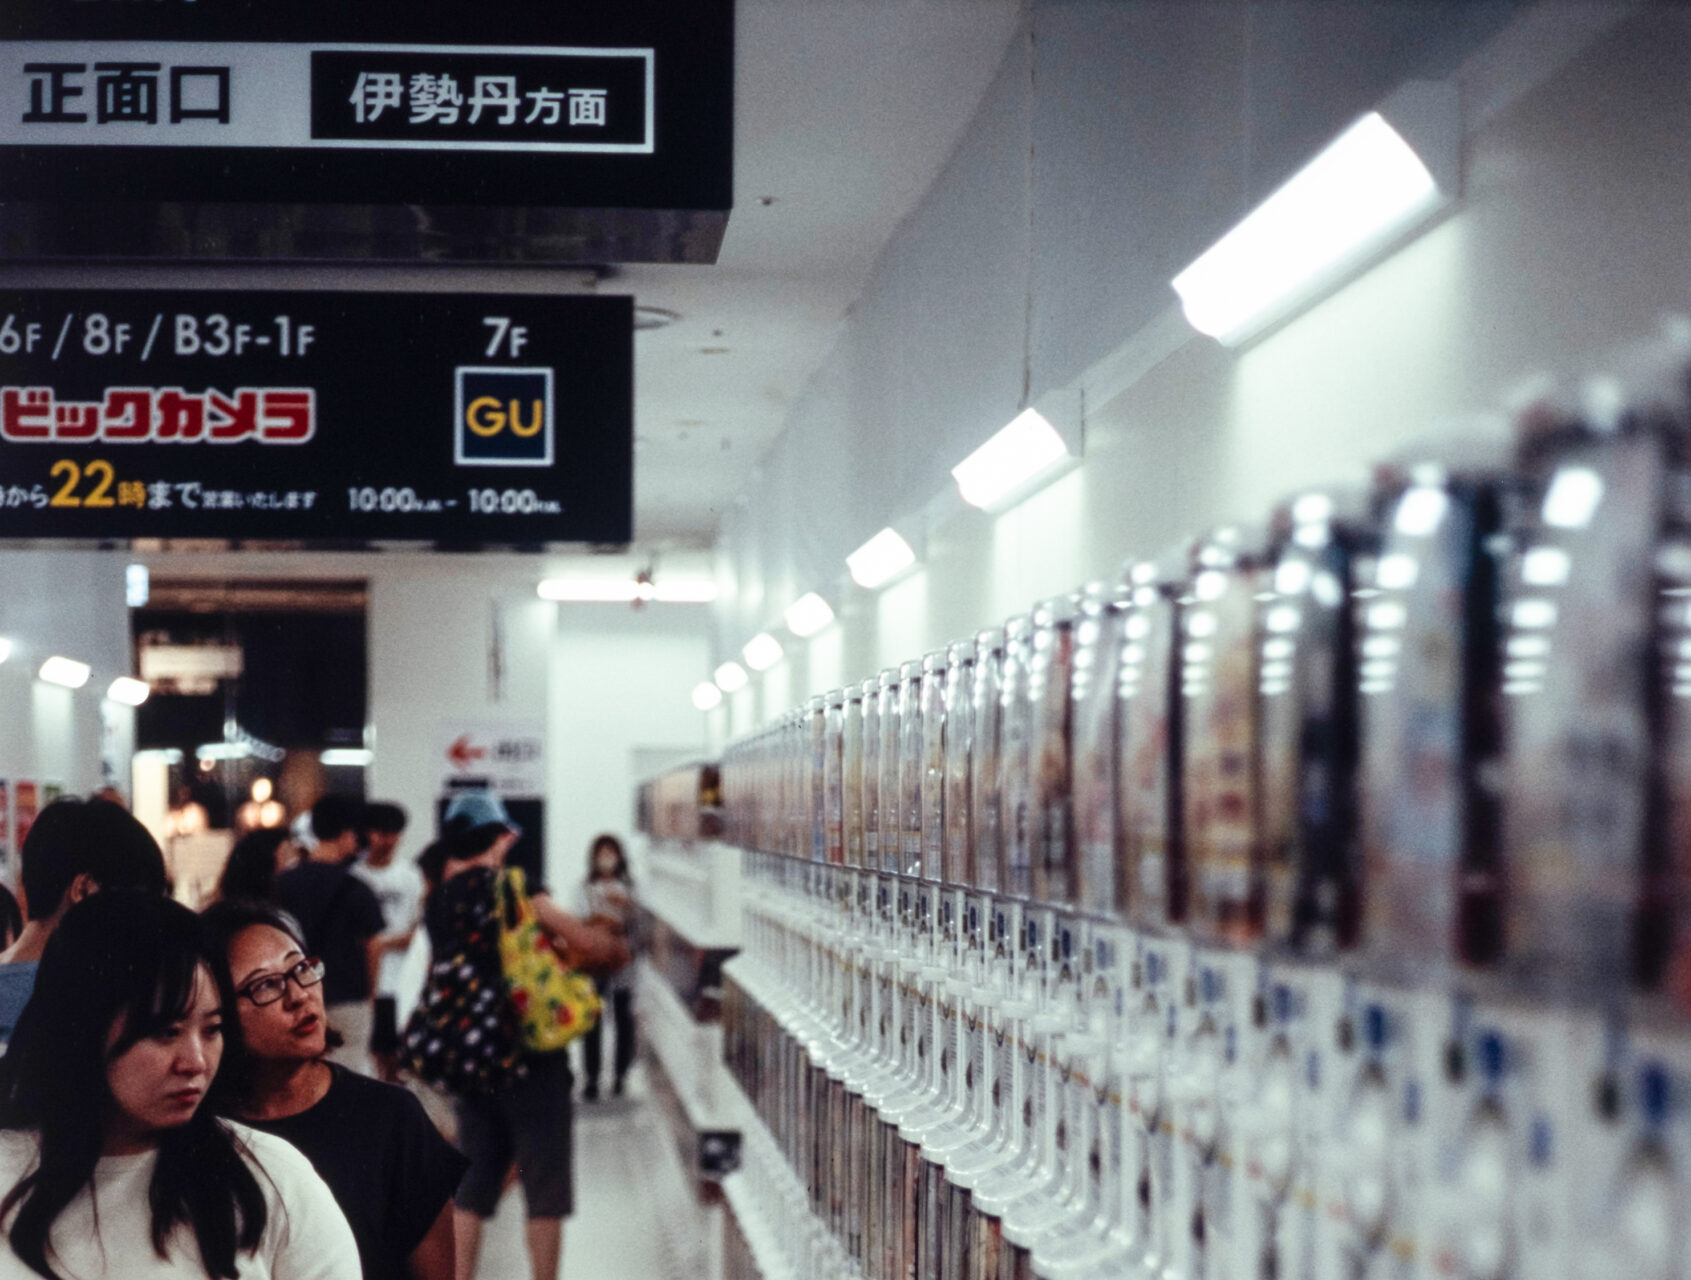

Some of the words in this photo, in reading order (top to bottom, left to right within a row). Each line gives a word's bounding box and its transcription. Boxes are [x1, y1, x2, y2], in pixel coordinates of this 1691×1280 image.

[22, 62, 231, 125] 正面口
[349, 71, 608, 127] 伊勢丹方面
[0, 314, 41, 354] 6F
[83, 313, 131, 355] 8F
[175, 314, 315, 356] B3F-1F
[483, 316, 528, 358] 7F
[0, 386, 316, 444] ビックカメラ
[466, 397, 545, 437] GU
